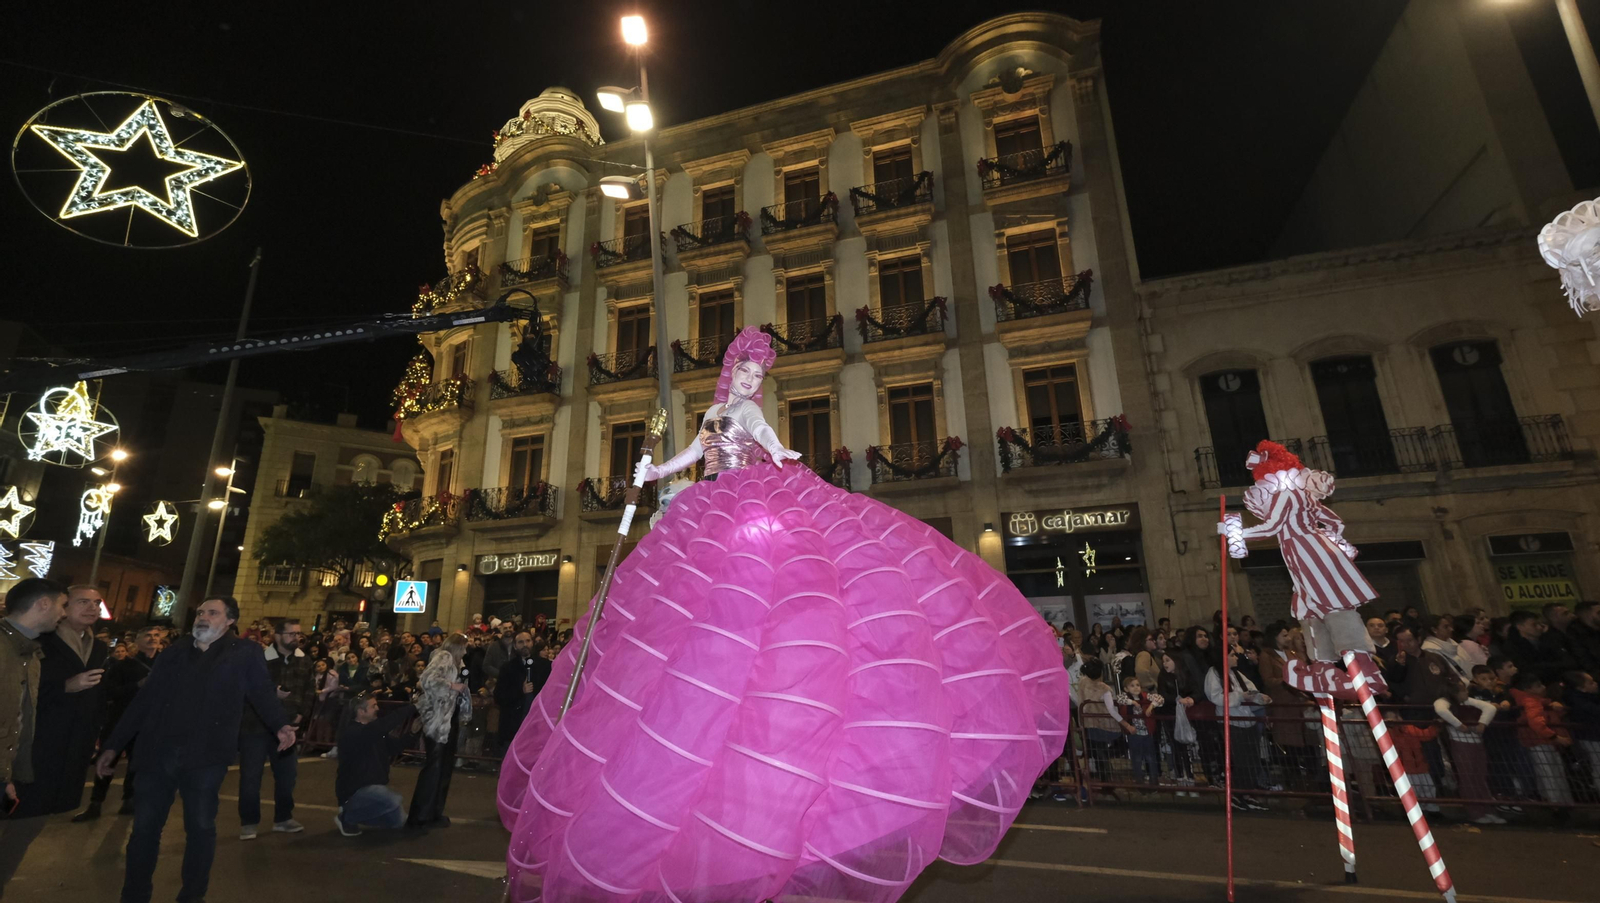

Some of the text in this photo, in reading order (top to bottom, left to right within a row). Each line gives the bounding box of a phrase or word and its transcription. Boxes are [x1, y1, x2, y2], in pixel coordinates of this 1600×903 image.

[1042, 509, 1130, 533] cajamar
[501, 553, 557, 572] cajamar
[1498, 564, 1567, 580] SE VENDE
[1504, 584, 1574, 599] O ALQUILA
